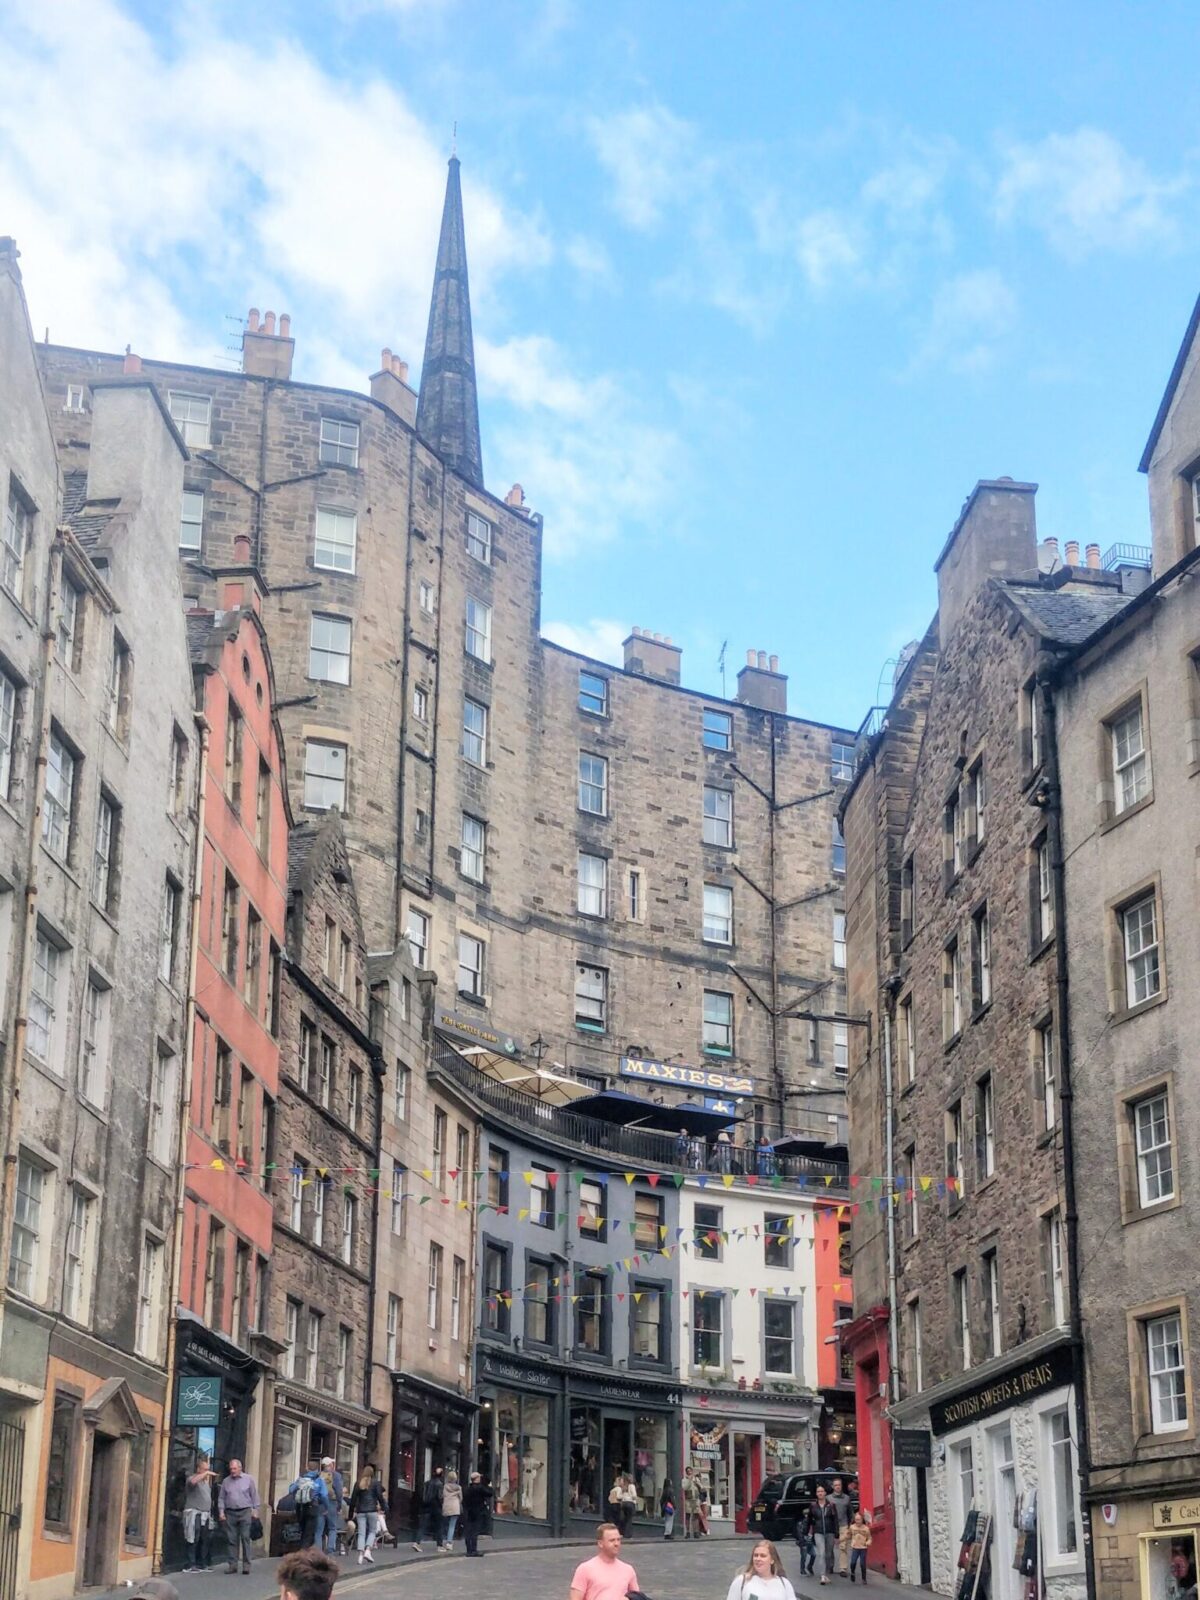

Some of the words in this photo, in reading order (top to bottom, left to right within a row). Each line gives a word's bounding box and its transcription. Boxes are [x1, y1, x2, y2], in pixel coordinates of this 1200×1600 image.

[625, 1059, 724, 1088] MAXIES
[527, 1370, 551, 1385] Slater
[600, 1386, 640, 1399] LADIESWEAR
[944, 1395, 980, 1424] SCOTTISH
[980, 1381, 1011, 1410] SWEETS
[1012, 1377, 1021, 1396] &
[1020, 1362, 1053, 1392] TREATS
